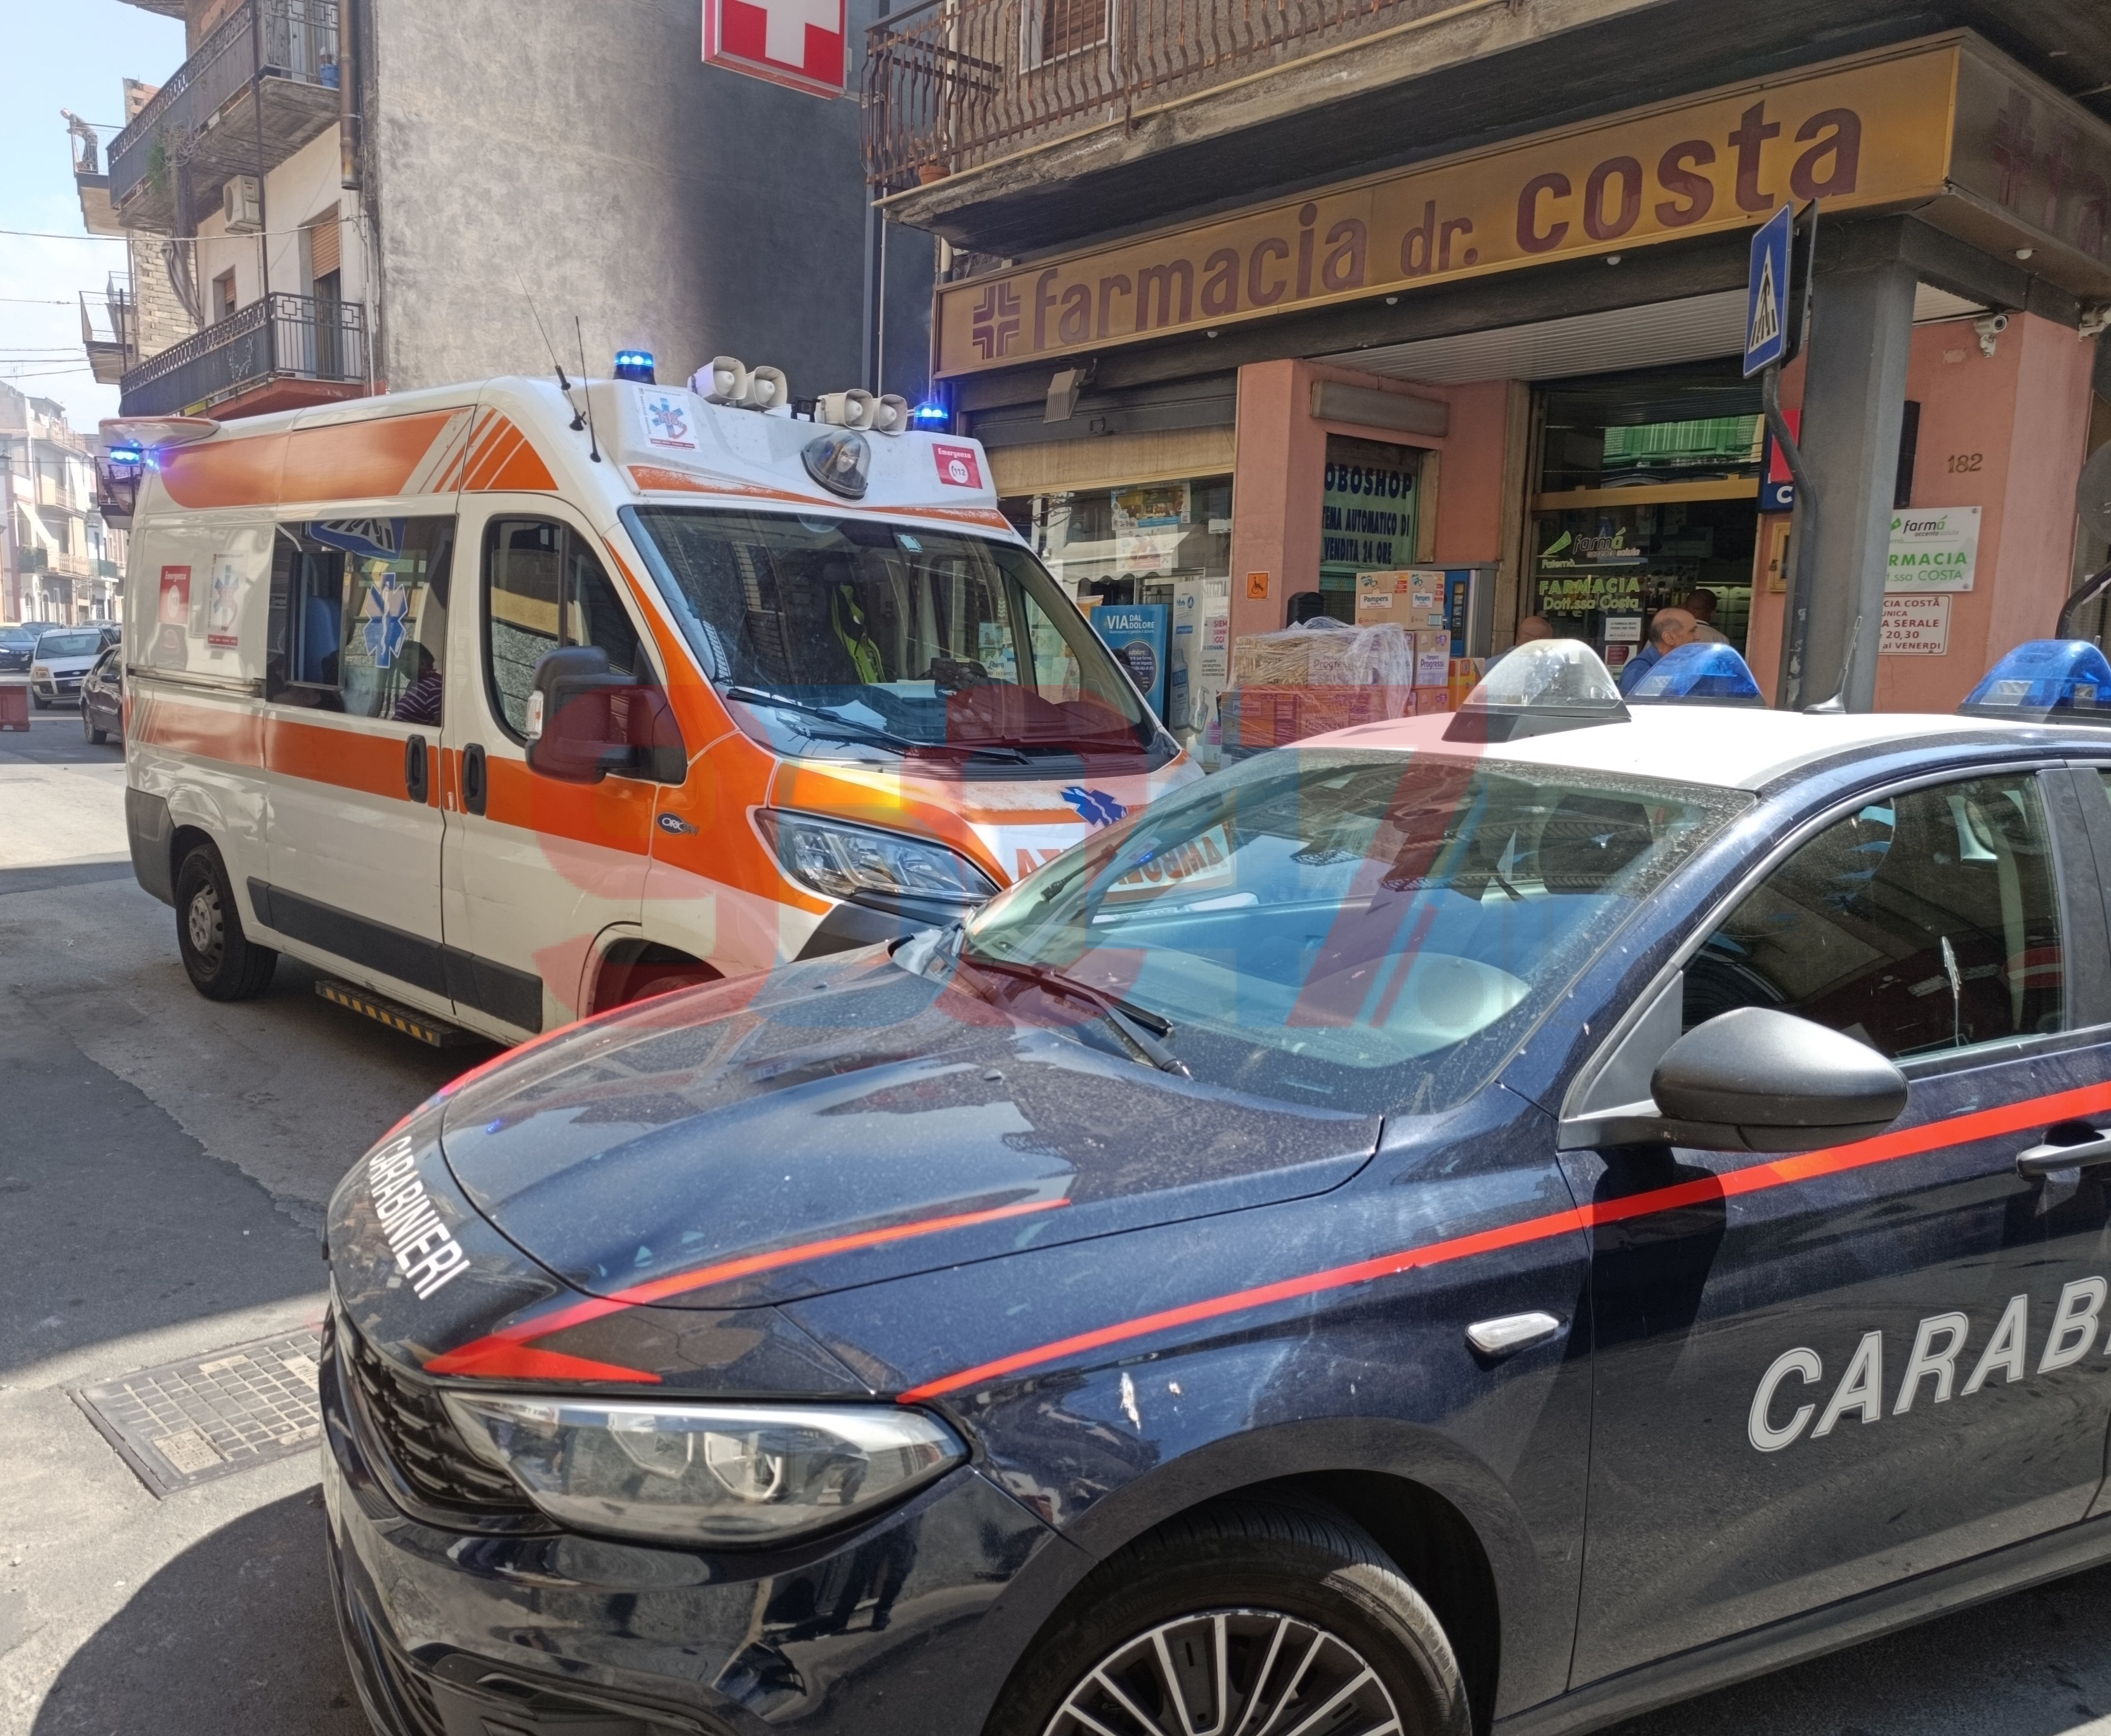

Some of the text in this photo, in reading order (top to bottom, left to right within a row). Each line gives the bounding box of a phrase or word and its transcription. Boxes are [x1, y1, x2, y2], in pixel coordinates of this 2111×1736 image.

[1034, 99, 1863, 351] farmacia dr. costa
[655, 410, 680, 426] 118
[938, 447, 972, 458] Emergenza
[1947, 453, 1984, 474] 182
[953, 468, 966, 476] 112
[1345, 508, 1398, 536] AUTOMATICO
[1401, 514, 1410, 537] DI
[1324, 536, 1392, 565] VENDITA 24 ORE
[165, 571, 186, 582] Emergenza
[1917, 569, 1963, 582] COSTA
[1539, 577, 1641, 595] FARMACIA
[1543, 594, 1639, 611] Dott.ssa Costa
[1106, 614, 1130, 630] VIA
[1893, 619, 1940, 628] SERALE
[1886, 630, 1920, 640] 20,30
[1420, 659, 1445, 670] Progressi
[1234, 705, 1260, 713] Progressi
[368, 1135, 470, 1301] CARABINIERI
[1748, 1275, 2111, 1452] CARAB
